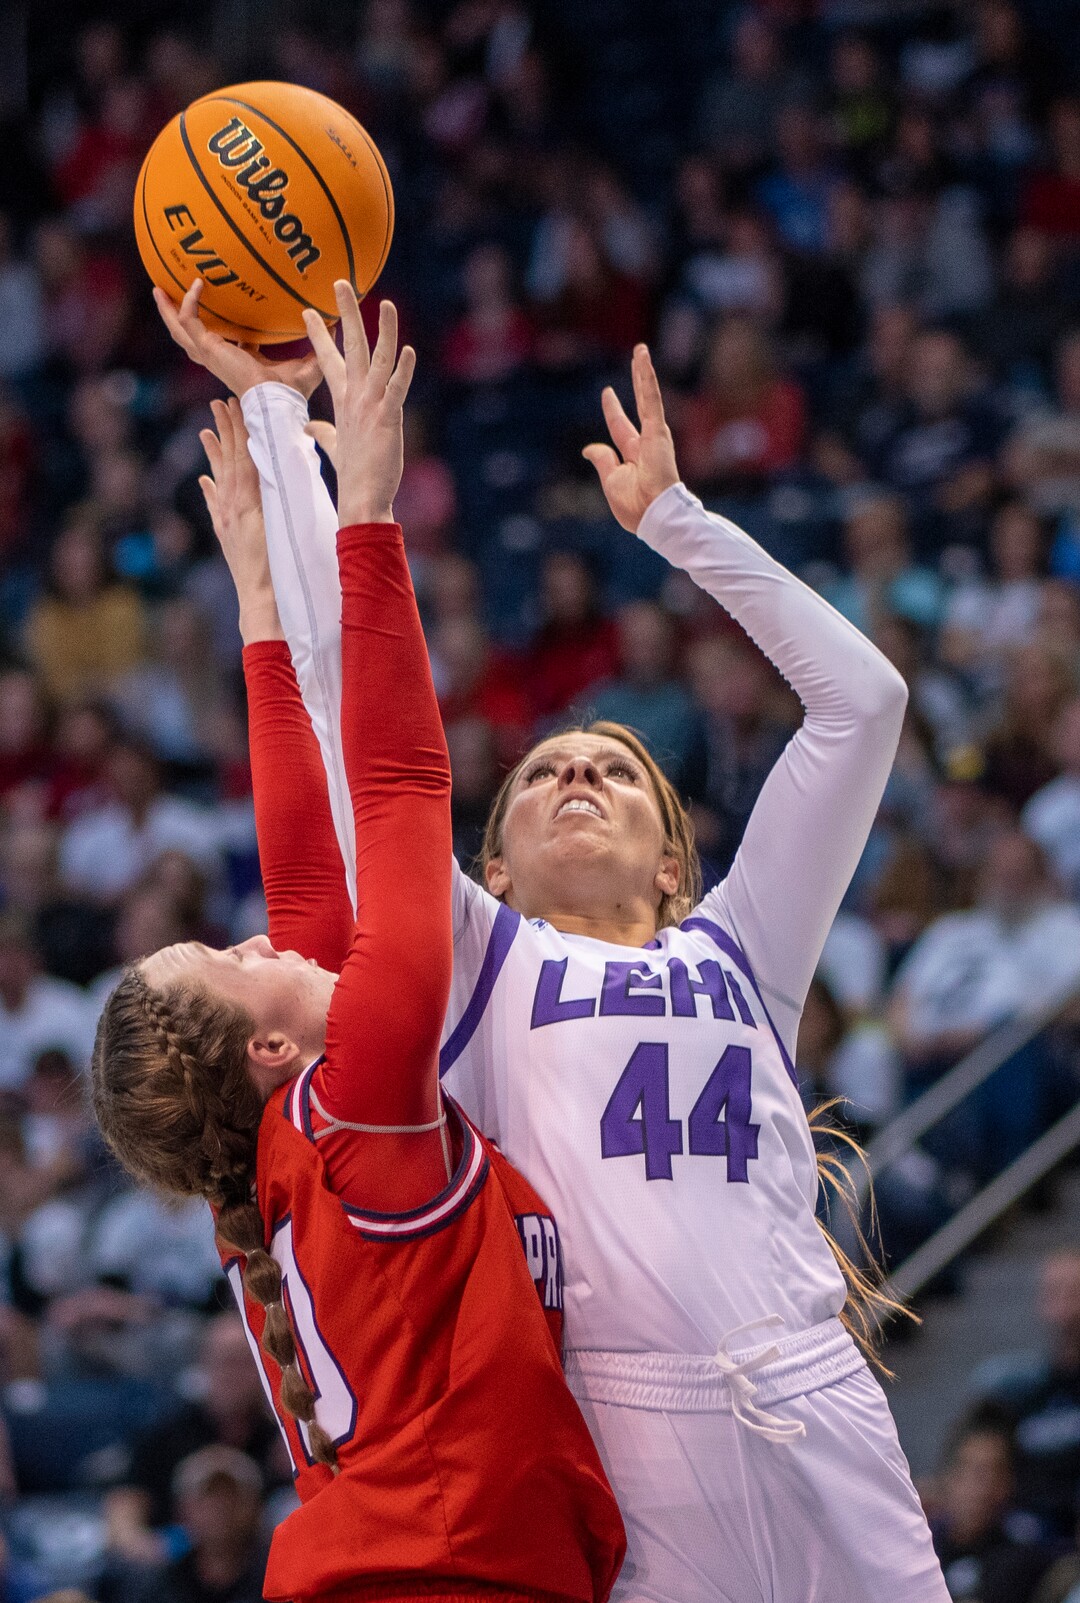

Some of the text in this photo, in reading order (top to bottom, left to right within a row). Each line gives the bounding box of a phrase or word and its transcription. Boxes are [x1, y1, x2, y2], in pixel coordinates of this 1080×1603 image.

[207, 116, 321, 275] Wilson
[221, 174, 243, 202] INDOOR
[242, 202, 260, 225] GAME
[163, 203, 240, 287] EVO
[236, 280, 269, 303] NXT
[530, 956, 759, 1031] LEHI
[600, 1041, 762, 1185] 44
[514, 1212, 564, 1312] PR
